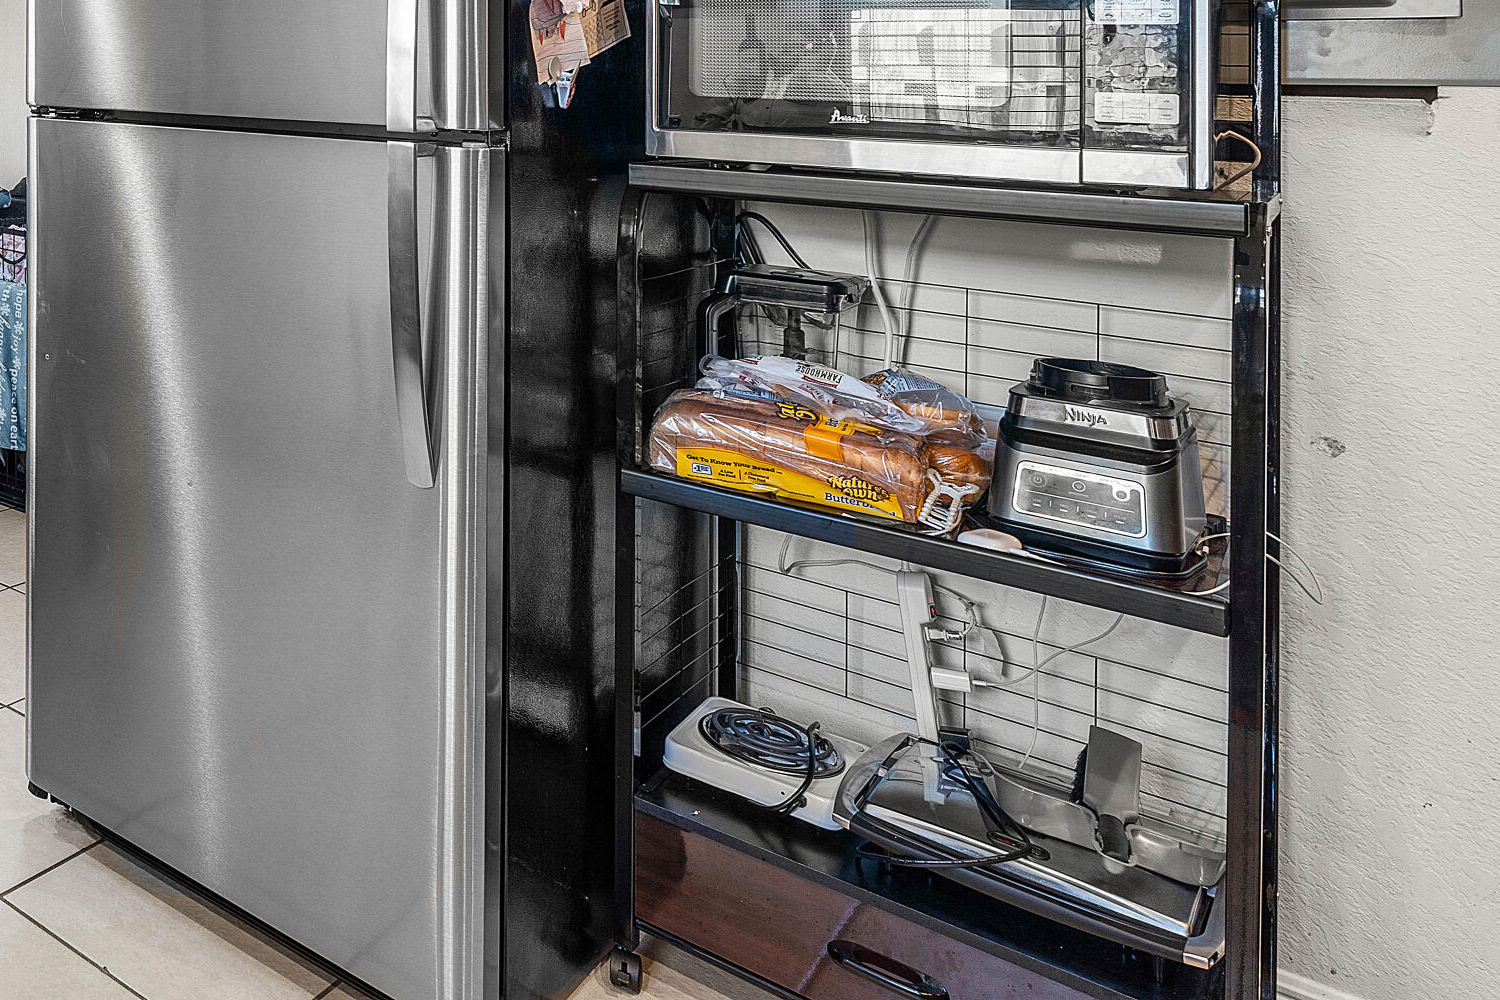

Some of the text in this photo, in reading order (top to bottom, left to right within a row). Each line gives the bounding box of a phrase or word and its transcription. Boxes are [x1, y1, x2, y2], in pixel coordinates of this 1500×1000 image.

[14, 290, 26, 318] hope
[11, 334, 21, 354] joy
[795, 363, 844, 384] FARMHOUSE
[9, 368, 18, 404] peace
[11, 406, 18, 422] on
[1065, 408, 1107, 427] NINJA
[710, 458, 732, 467] Know
[733, 461, 750, 469] Your
[752, 464, 775, 473] Bread
[843, 487, 884, 502] Own
